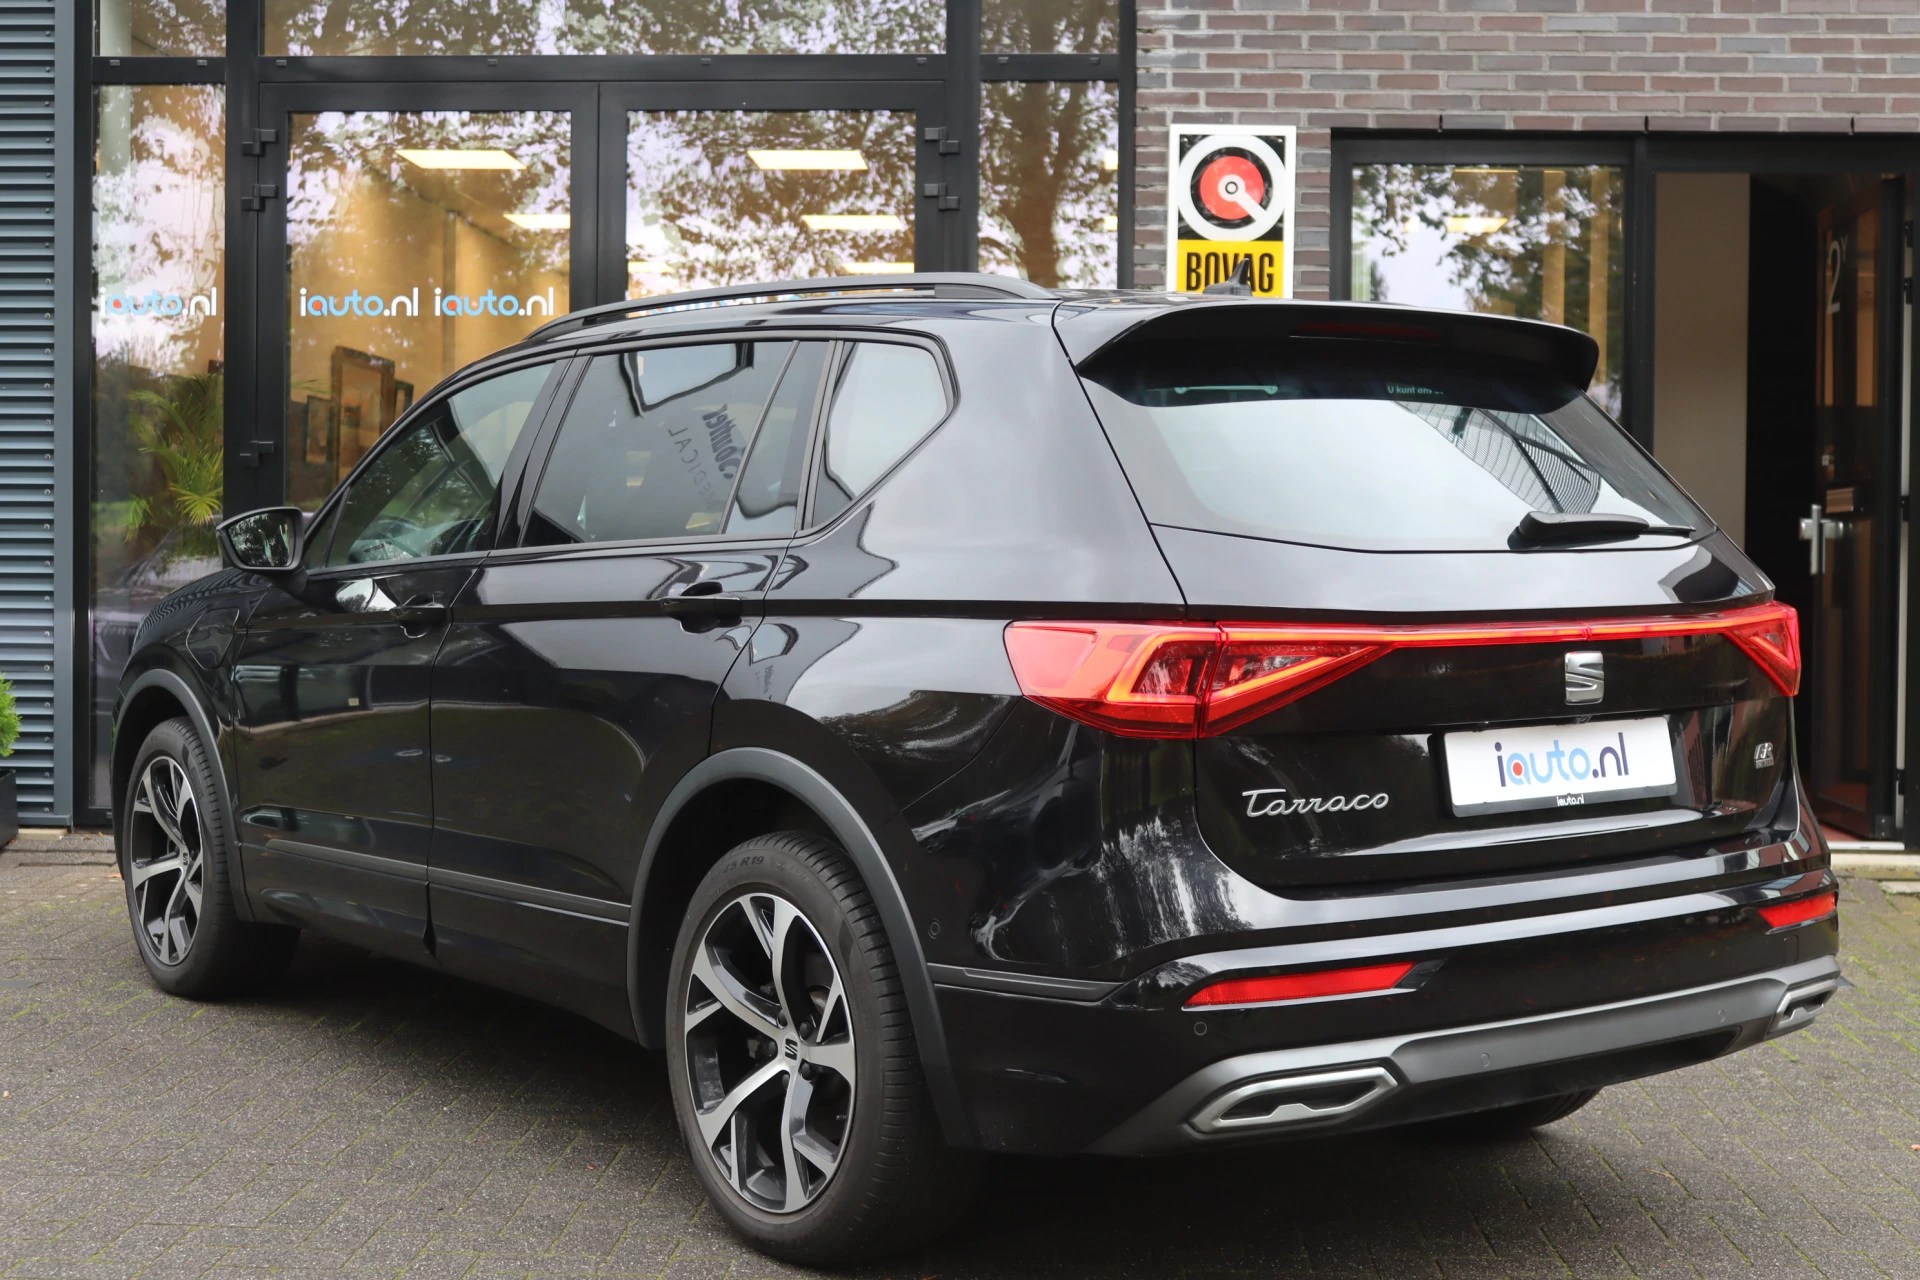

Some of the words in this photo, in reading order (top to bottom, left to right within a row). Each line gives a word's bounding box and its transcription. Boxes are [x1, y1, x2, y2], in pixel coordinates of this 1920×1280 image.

[1186, 252, 1275, 293] BOVAG
[99, 287, 217, 316] iauto.nl
[300, 287, 418, 317] iauto.nl
[435, 287, 554, 317] iauto.nl
[1495, 732, 1629, 787] iauto.nl
[1242, 788, 1389, 818] Tarraco
